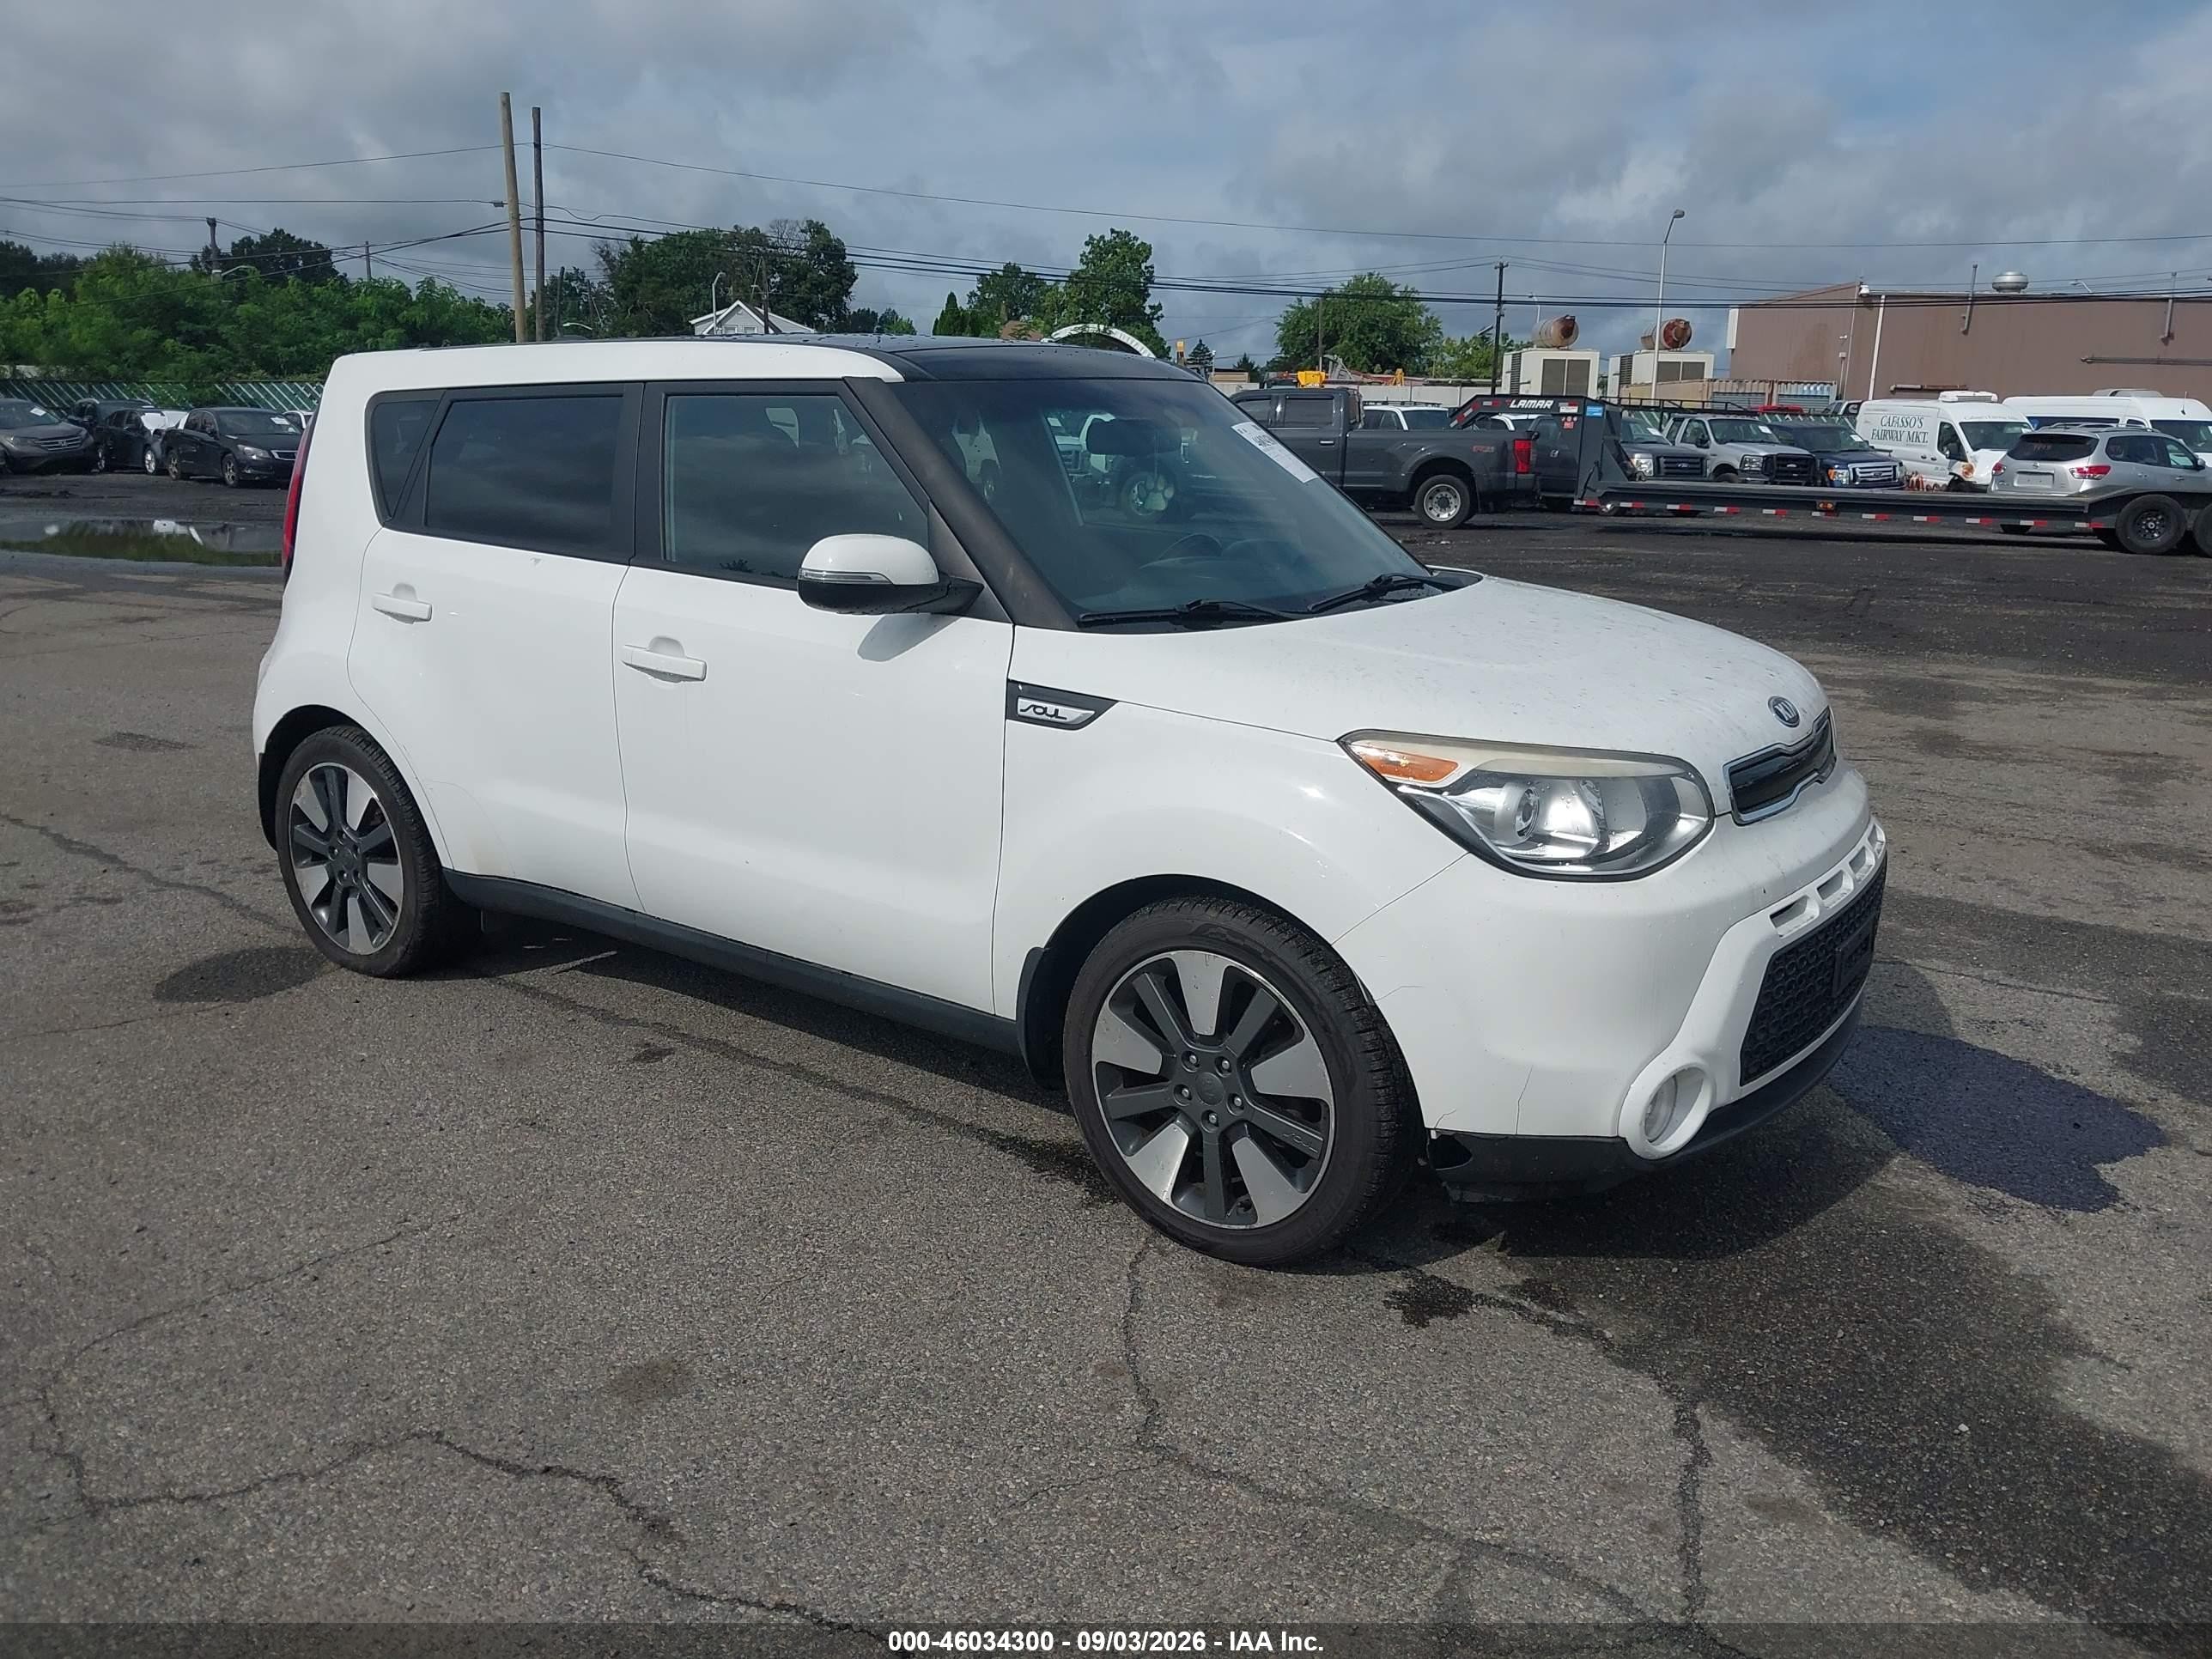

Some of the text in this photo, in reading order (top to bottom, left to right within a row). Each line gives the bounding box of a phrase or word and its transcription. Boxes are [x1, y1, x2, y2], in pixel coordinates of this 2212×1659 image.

[1509, 399, 1554, 410] LAMAR
[1881, 416, 1924, 428] CAFASSO'S
[1871, 428, 1929, 444] FAIRWAY MKT.
[1019, 704, 1067, 720] SOUL
